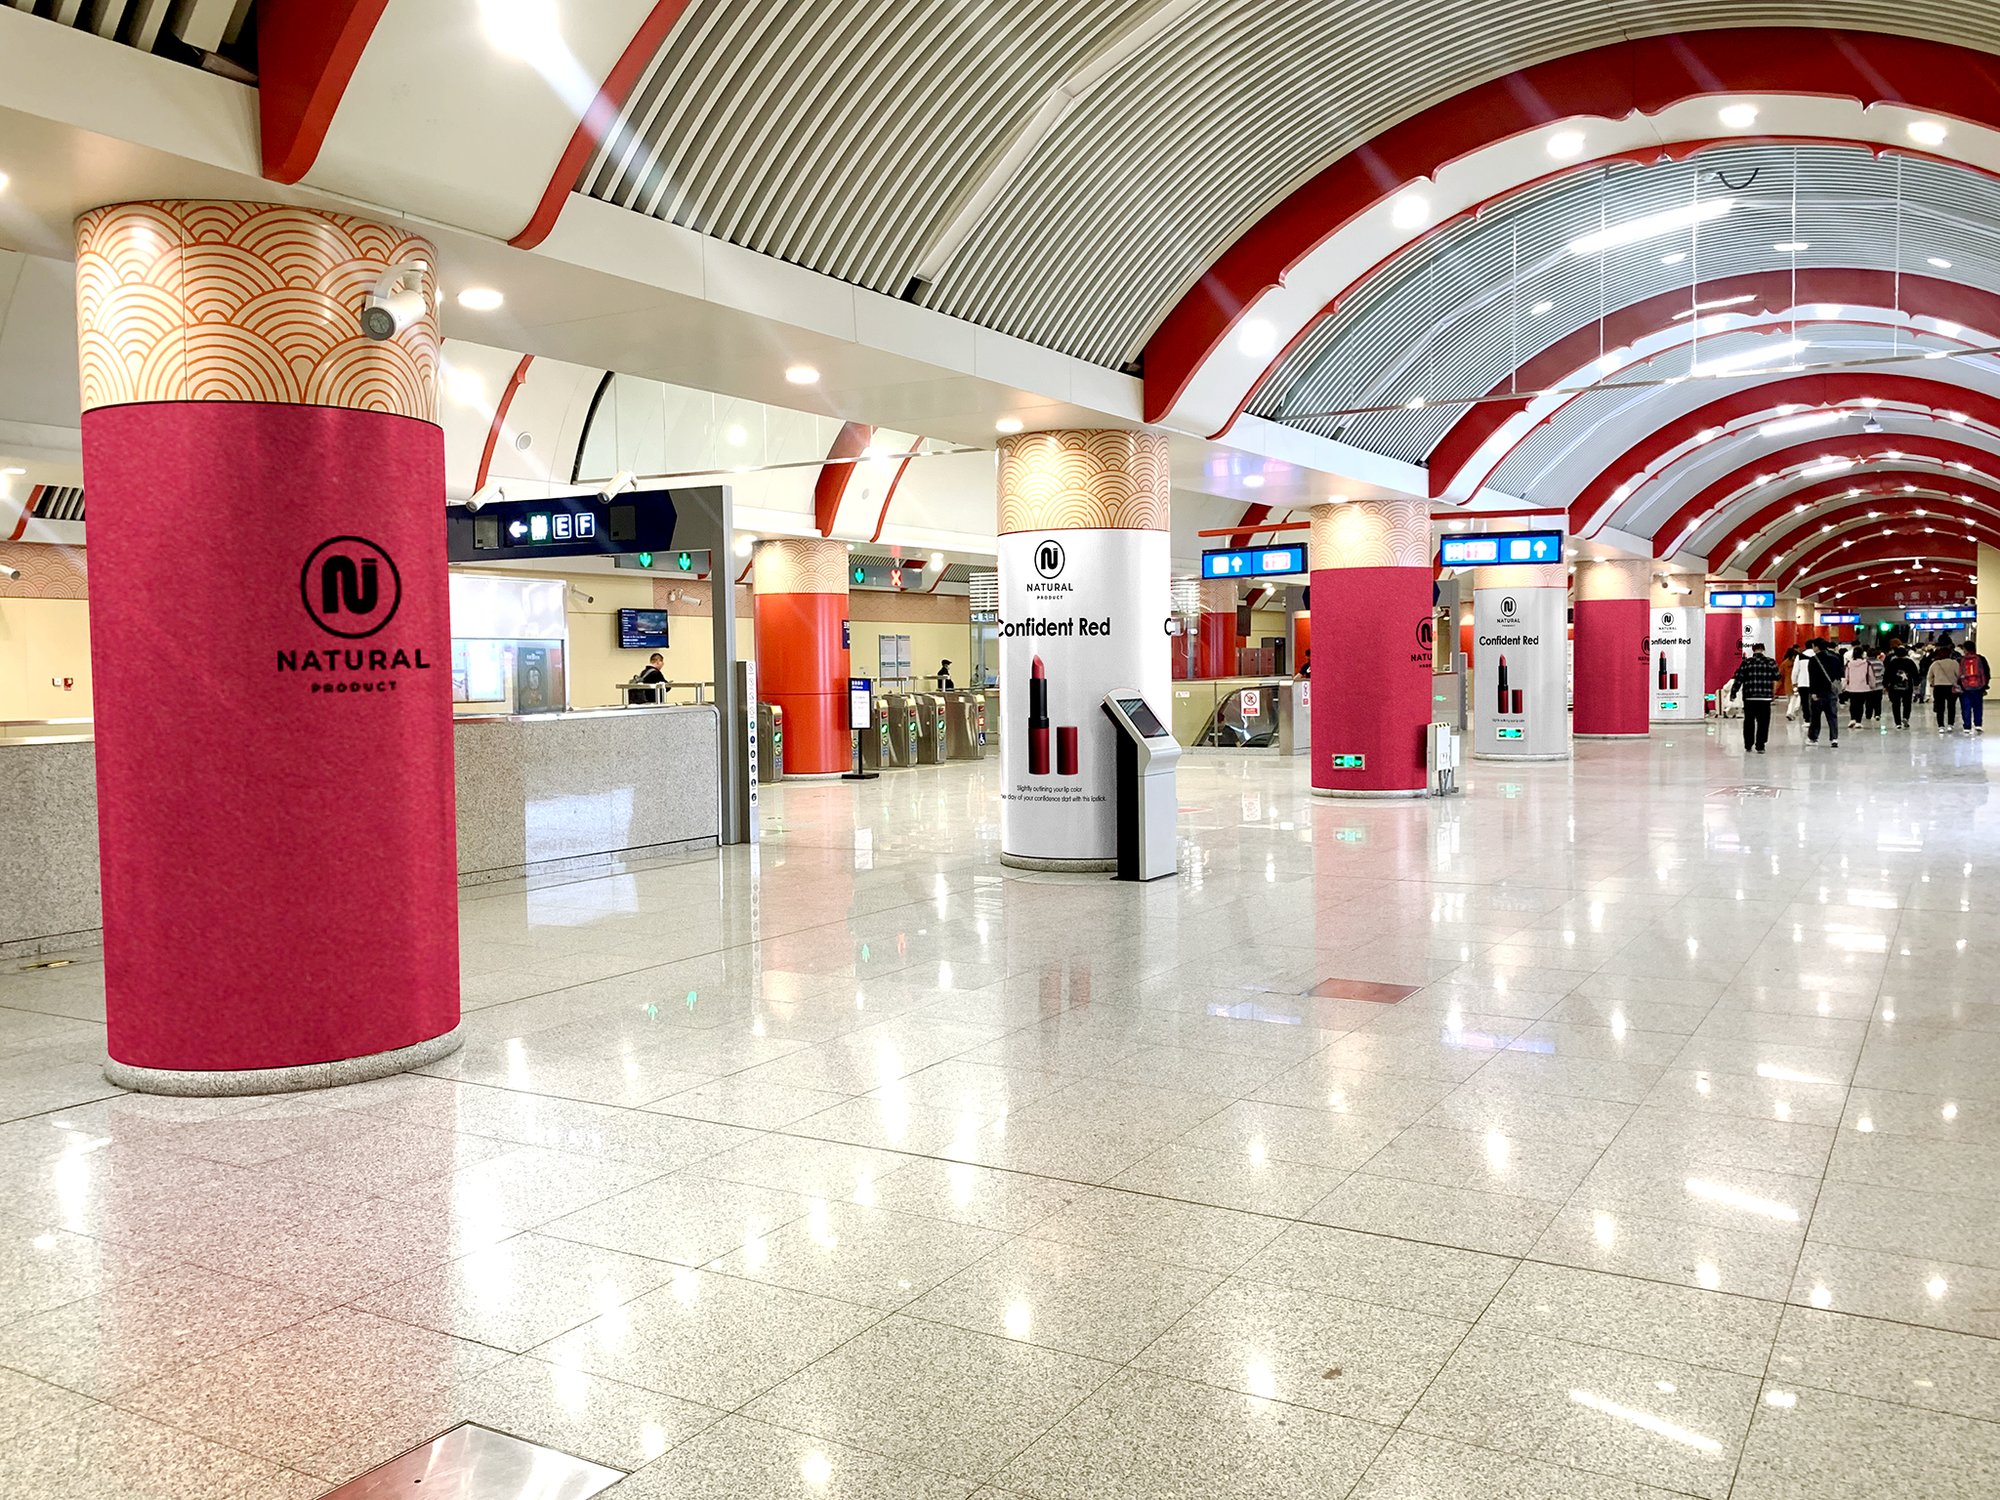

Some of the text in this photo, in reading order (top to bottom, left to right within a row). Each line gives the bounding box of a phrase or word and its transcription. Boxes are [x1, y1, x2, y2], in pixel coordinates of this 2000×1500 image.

[556, 517, 569, 536] E
[580, 515, 591, 534] F
[1026, 583, 1074, 592] NATURAL
[1079, 617, 1111, 637] Red
[1479, 635, 1539, 646] Confident Red
[277, 648, 430, 672] NATURAL
[311, 681, 397, 693] PRODUCT
[1017, 785, 1032, 793] Slightly
